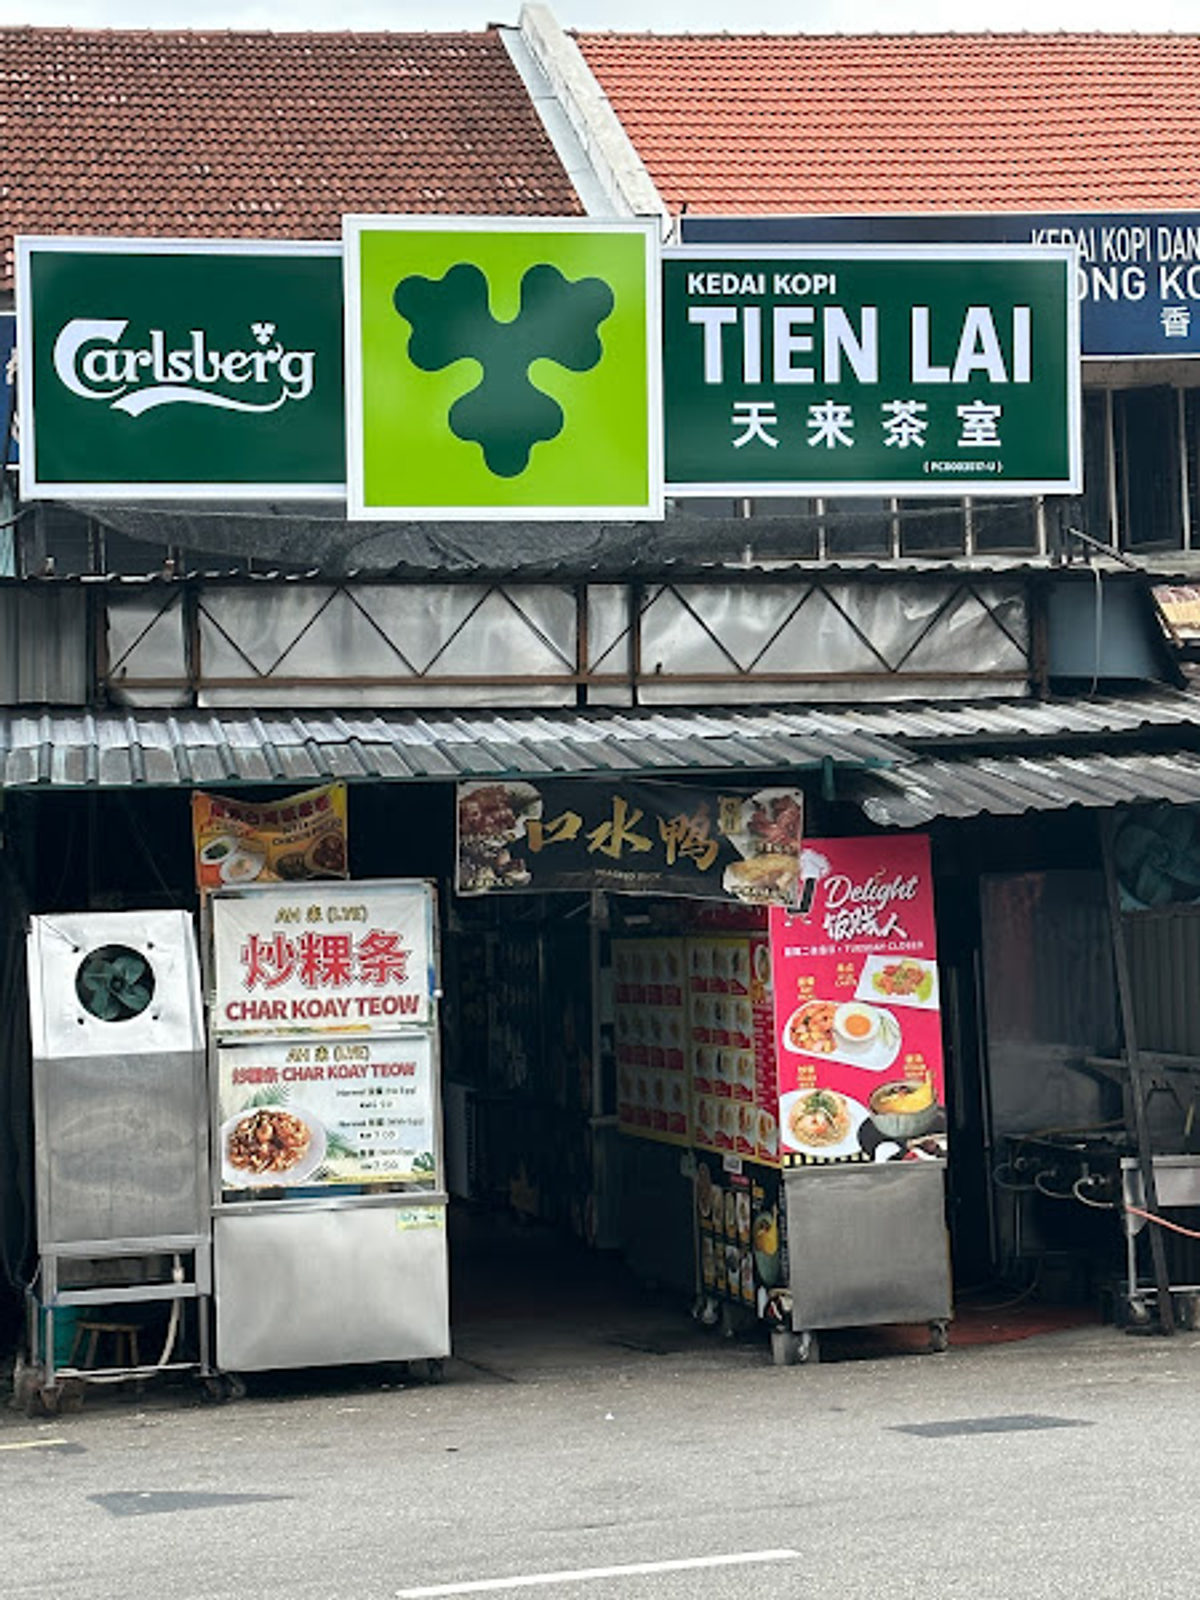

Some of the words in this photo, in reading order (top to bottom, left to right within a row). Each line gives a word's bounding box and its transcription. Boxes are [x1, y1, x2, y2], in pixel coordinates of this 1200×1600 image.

[1102, 227, 1151, 262] KOPI
[1157, 226, 1200, 262] DAN
[687, 273, 765, 295] KEDAI
[773, 273, 836, 295] KOPI
[1160, 306, 1191, 337] 香
[54, 319, 315, 401] Carlsberg
[688, 306, 878, 383] TIEN
[911, 306, 1031, 383] LAI
[731, 400, 1004, 449] 天来茶室
[526, 795, 719, 871] 口水鸭
[824, 875, 918, 910] Delight
[242, 930, 410, 990] 炒粿条
[226, 1000, 287, 1020] CHAR
[292, 998, 353, 1019] KOAY
[353, 995, 419, 1015] TEOW
[282, 1065, 324, 1082] CHAR
[328, 1063, 368, 1080] KOAY
[369, 1062, 416, 1078] TEOW
